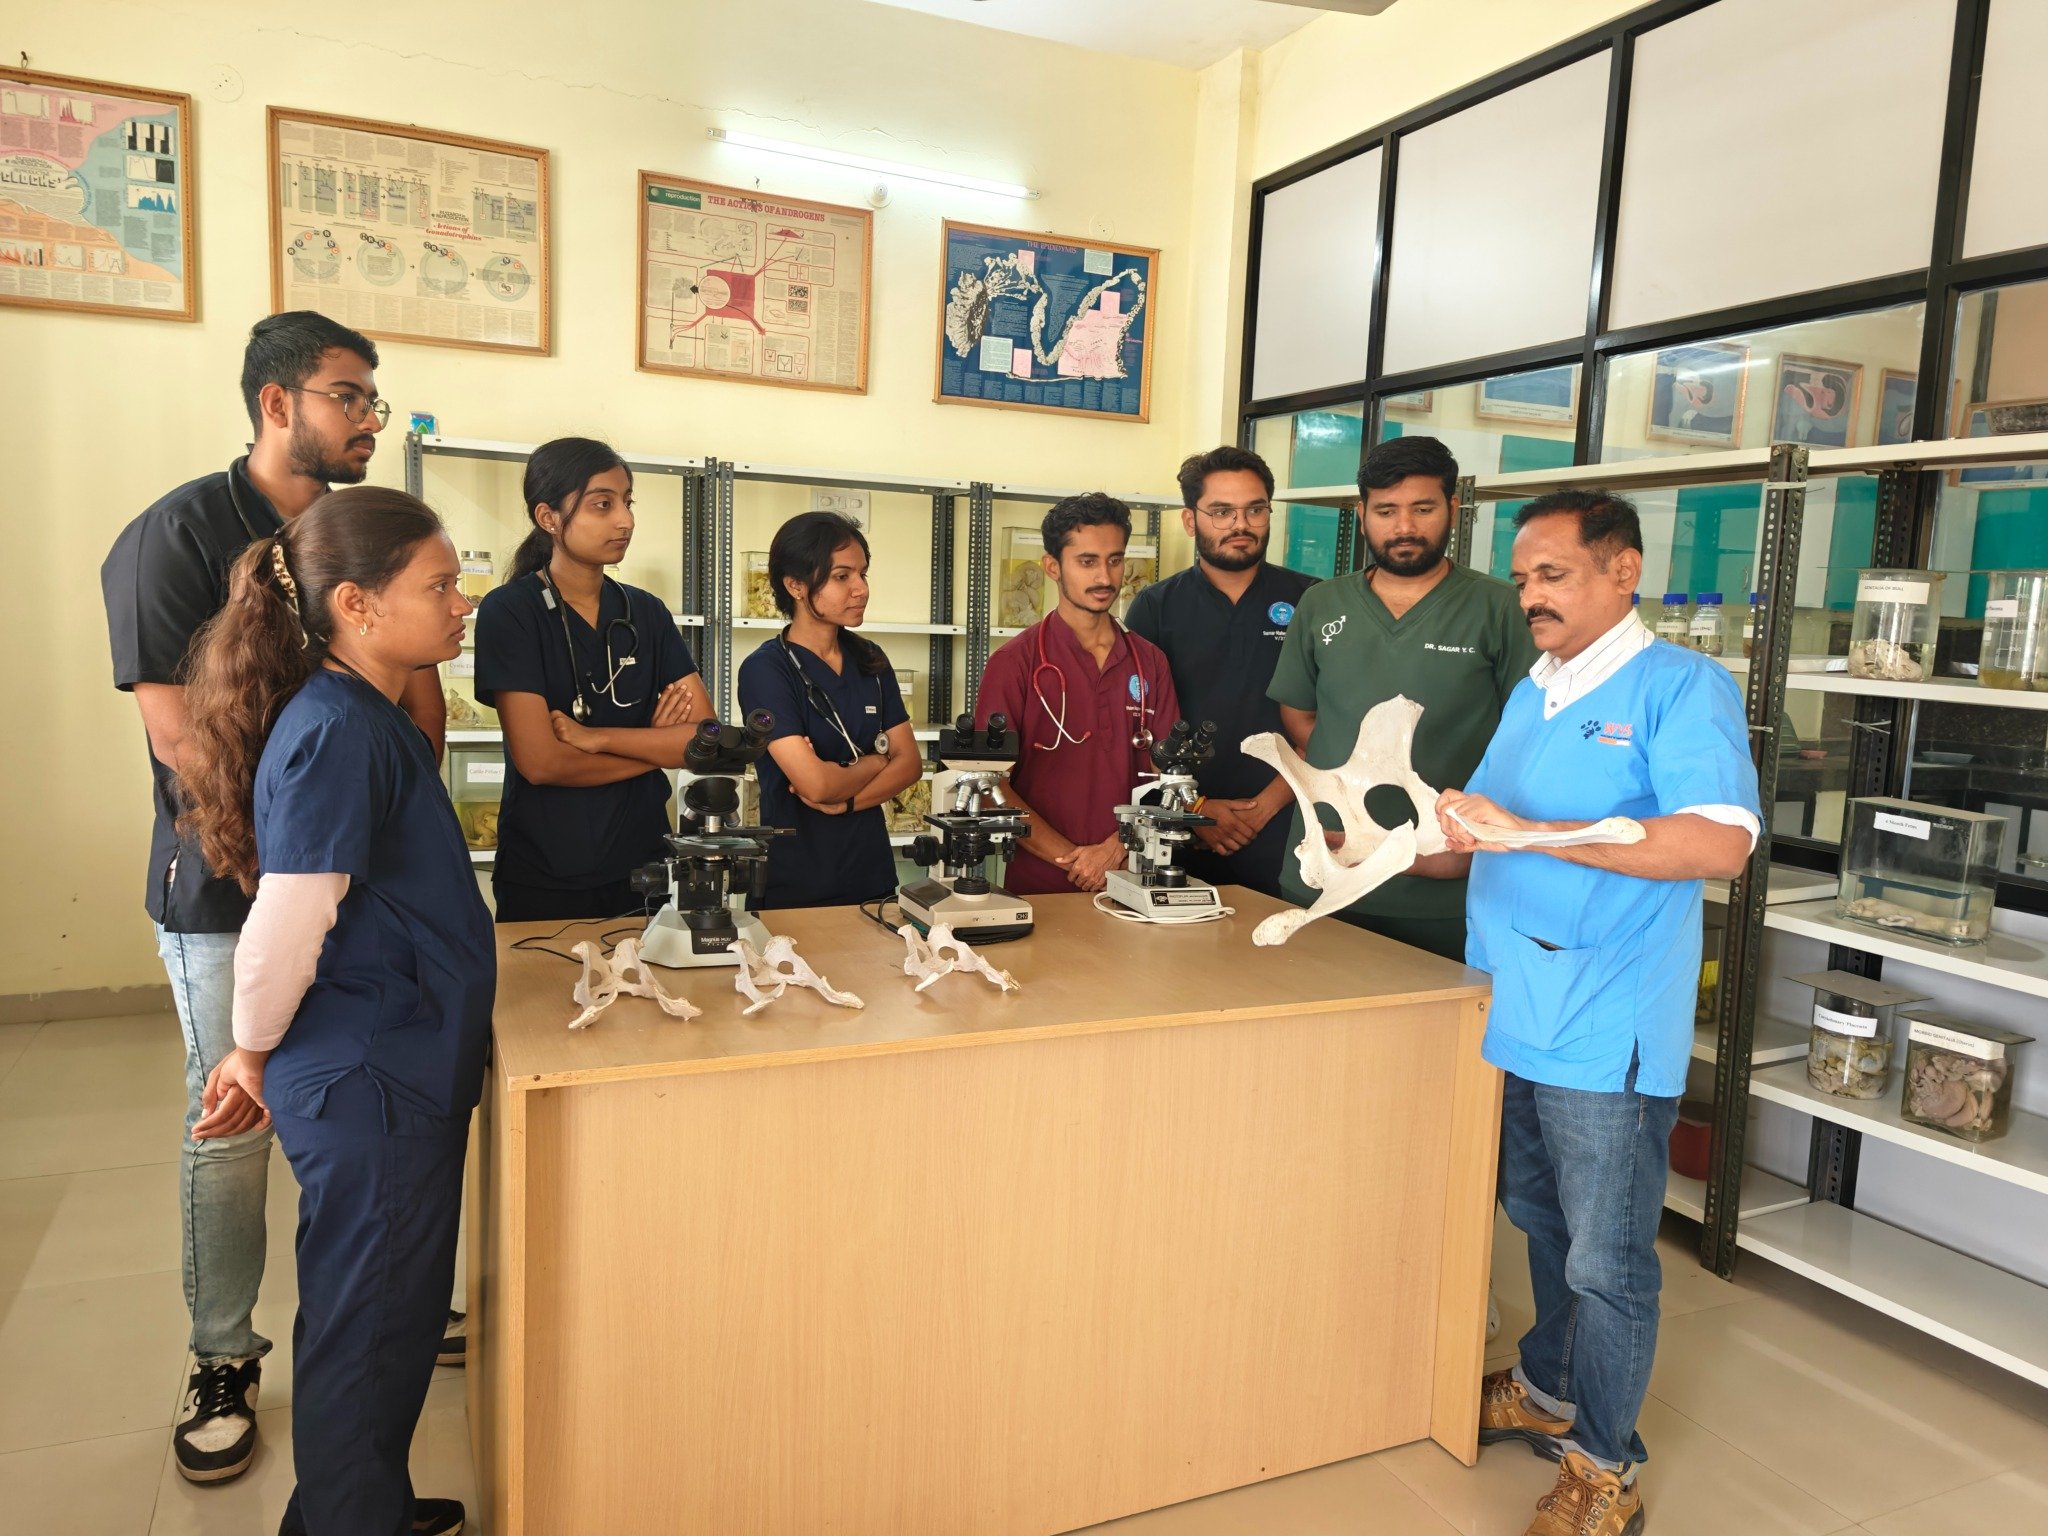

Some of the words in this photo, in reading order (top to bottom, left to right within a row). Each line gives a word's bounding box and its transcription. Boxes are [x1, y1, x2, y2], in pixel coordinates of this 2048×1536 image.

[665, 192, 700, 202] reproduction
[708, 195, 726, 206] THE
[765, 205, 776, 214] OF
[776, 206, 825, 222] ANDROGENS
[1027, 241, 1037, 249] THE
[1438, 645, 1460, 653] SAGAR
